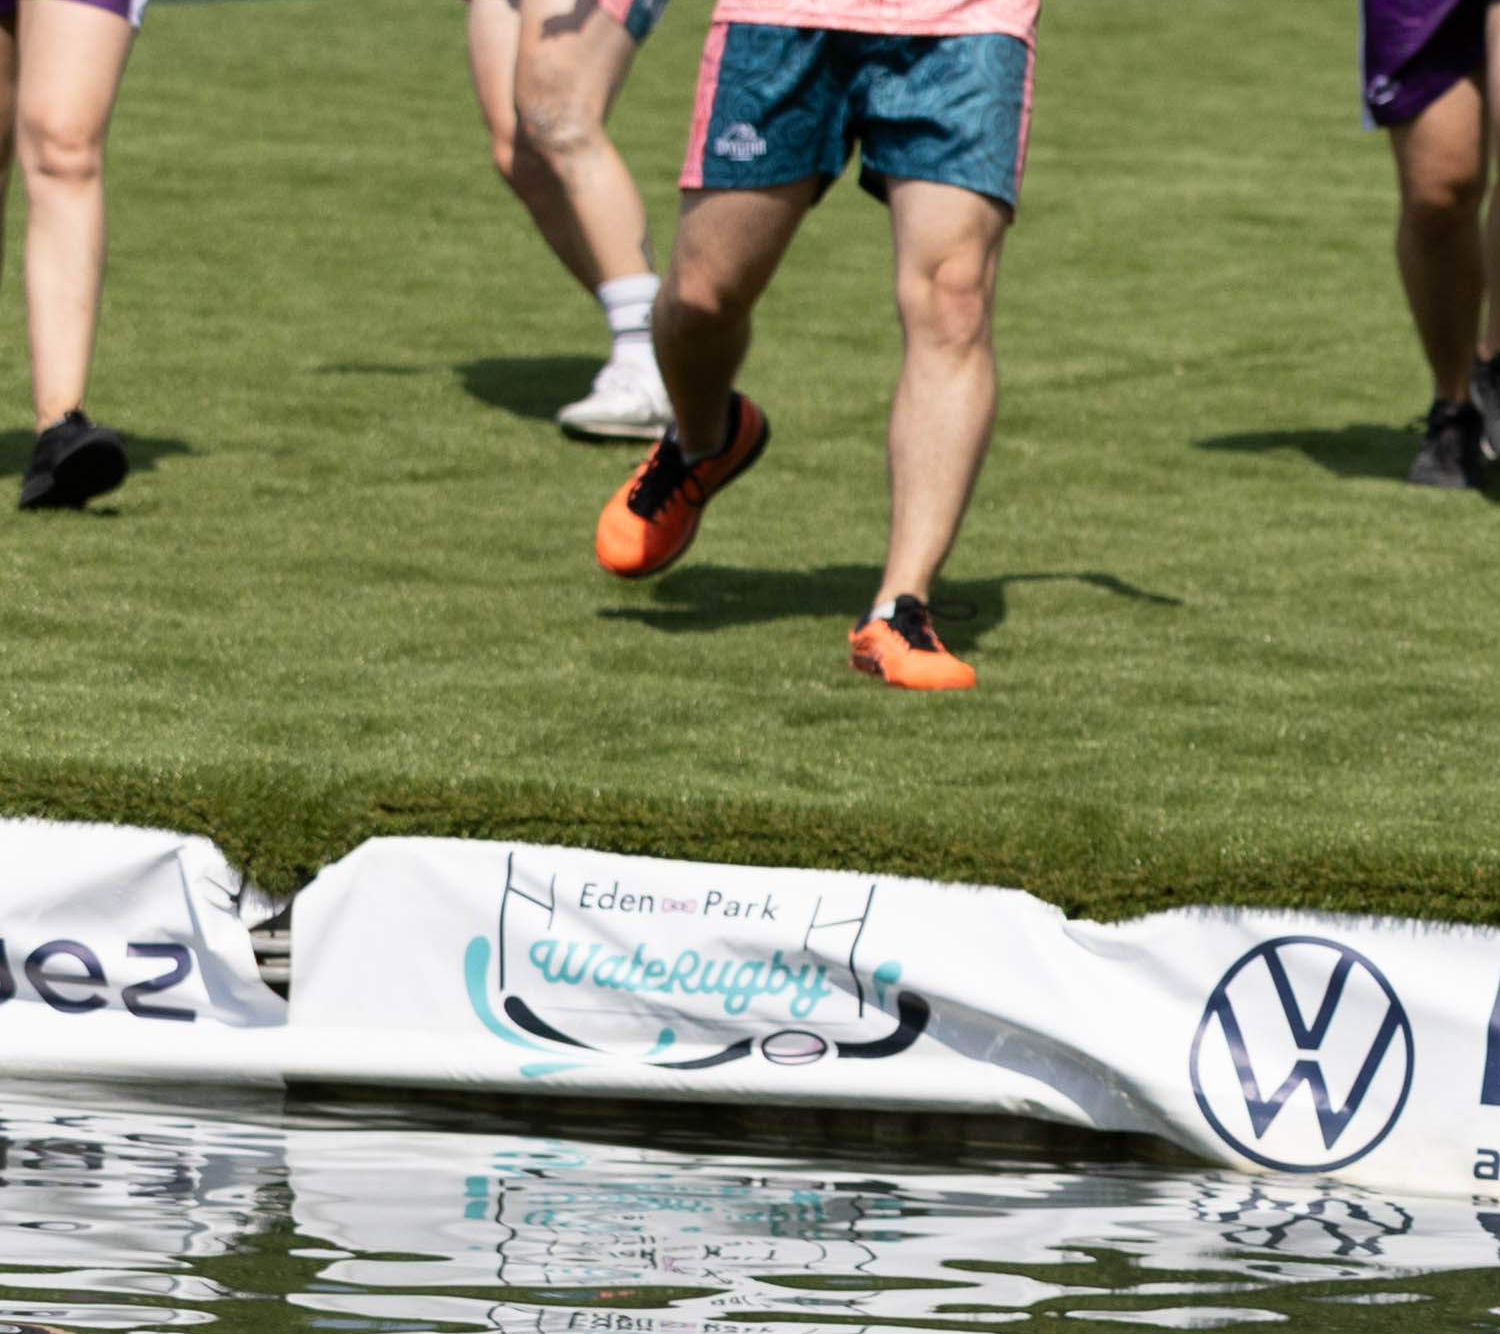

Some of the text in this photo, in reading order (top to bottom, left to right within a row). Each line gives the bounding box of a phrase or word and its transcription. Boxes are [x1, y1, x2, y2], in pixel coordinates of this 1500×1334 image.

[577, 881, 780, 922] Eden Park
[0, 937, 197, 1023] ez
[529, 938, 833, 1016] WateRugby
